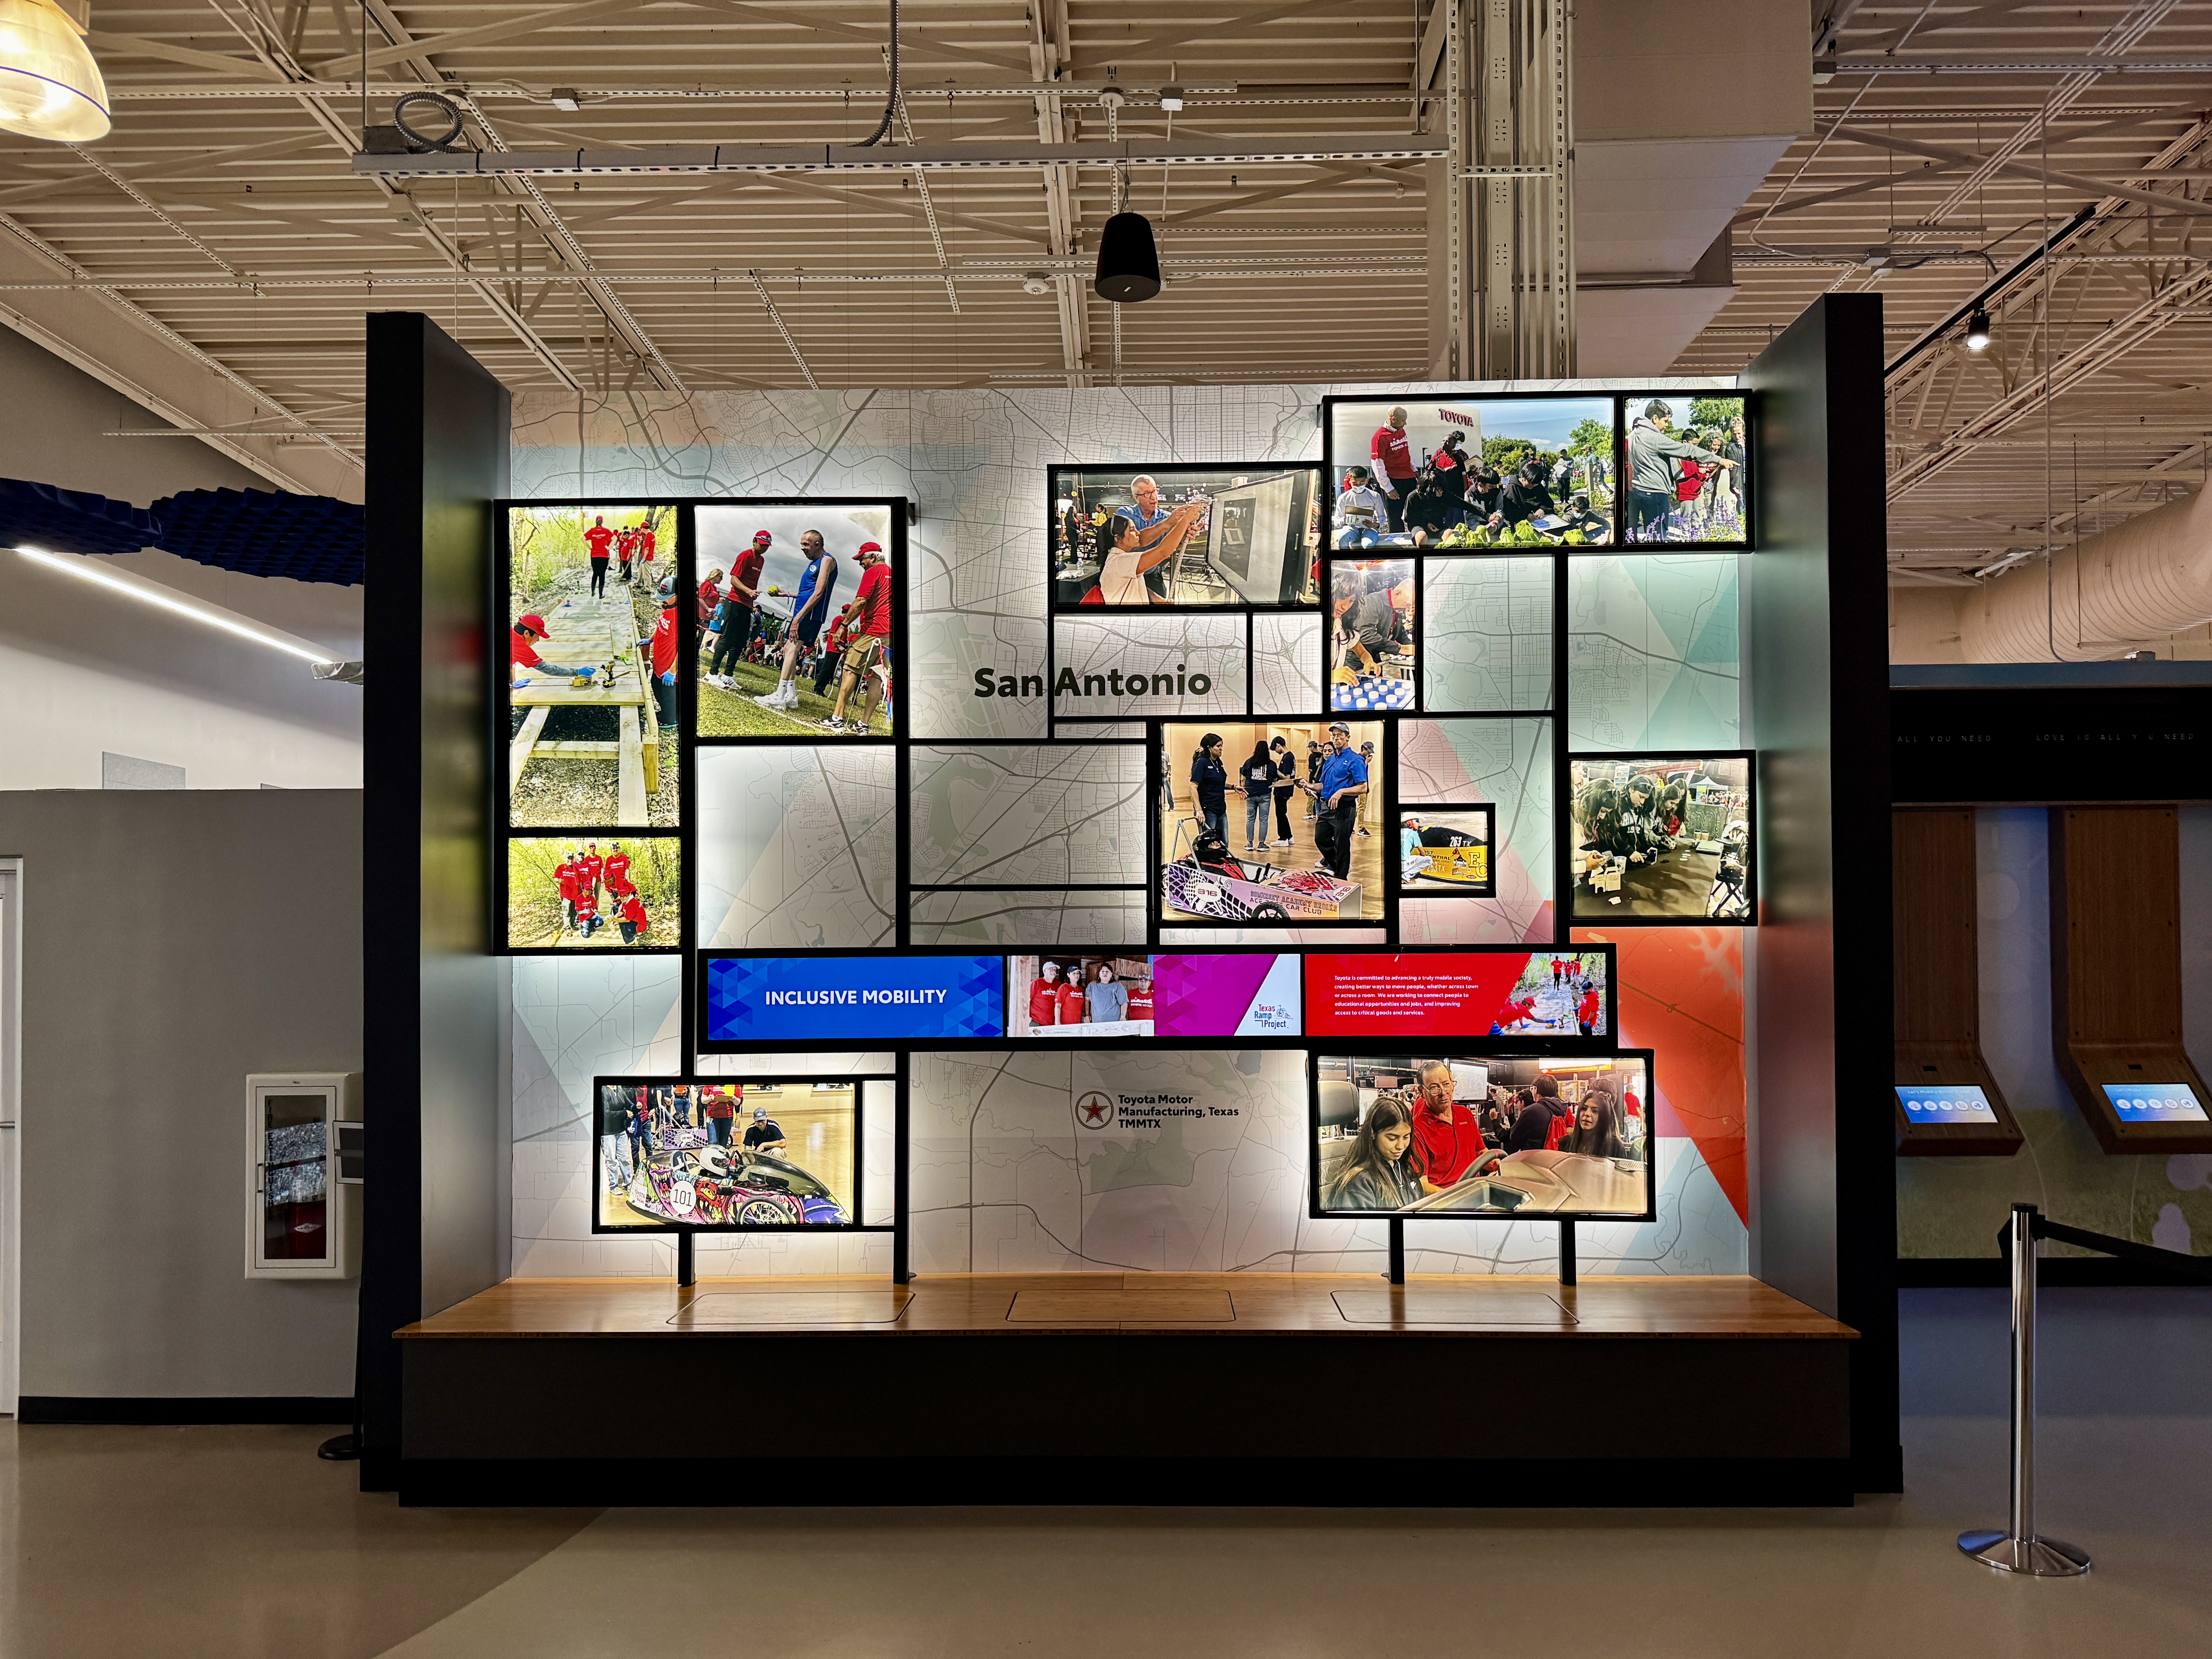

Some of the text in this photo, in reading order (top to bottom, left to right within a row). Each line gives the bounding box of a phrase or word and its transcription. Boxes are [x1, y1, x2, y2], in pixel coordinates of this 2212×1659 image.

[1439, 408, 1474, 427] TOYOTA
[974, 664, 1211, 697] San Antonio
[1450, 836, 1462, 847] 263
[1281, 896, 1312, 907] ACADEMY
[765, 989, 947, 1005] INCLUSIVE MOBILITY
[1254, 1011, 1271, 1020] Ramp
[1264, 1020, 1286, 1029] Project
[1118, 1095, 1193, 1106] Toyota Motor
[1118, 1106, 1239, 1118] Manufacturing, Texas
[1118, 1119, 1161, 1128] TMMTX
[673, 1189, 692, 1207] 101
